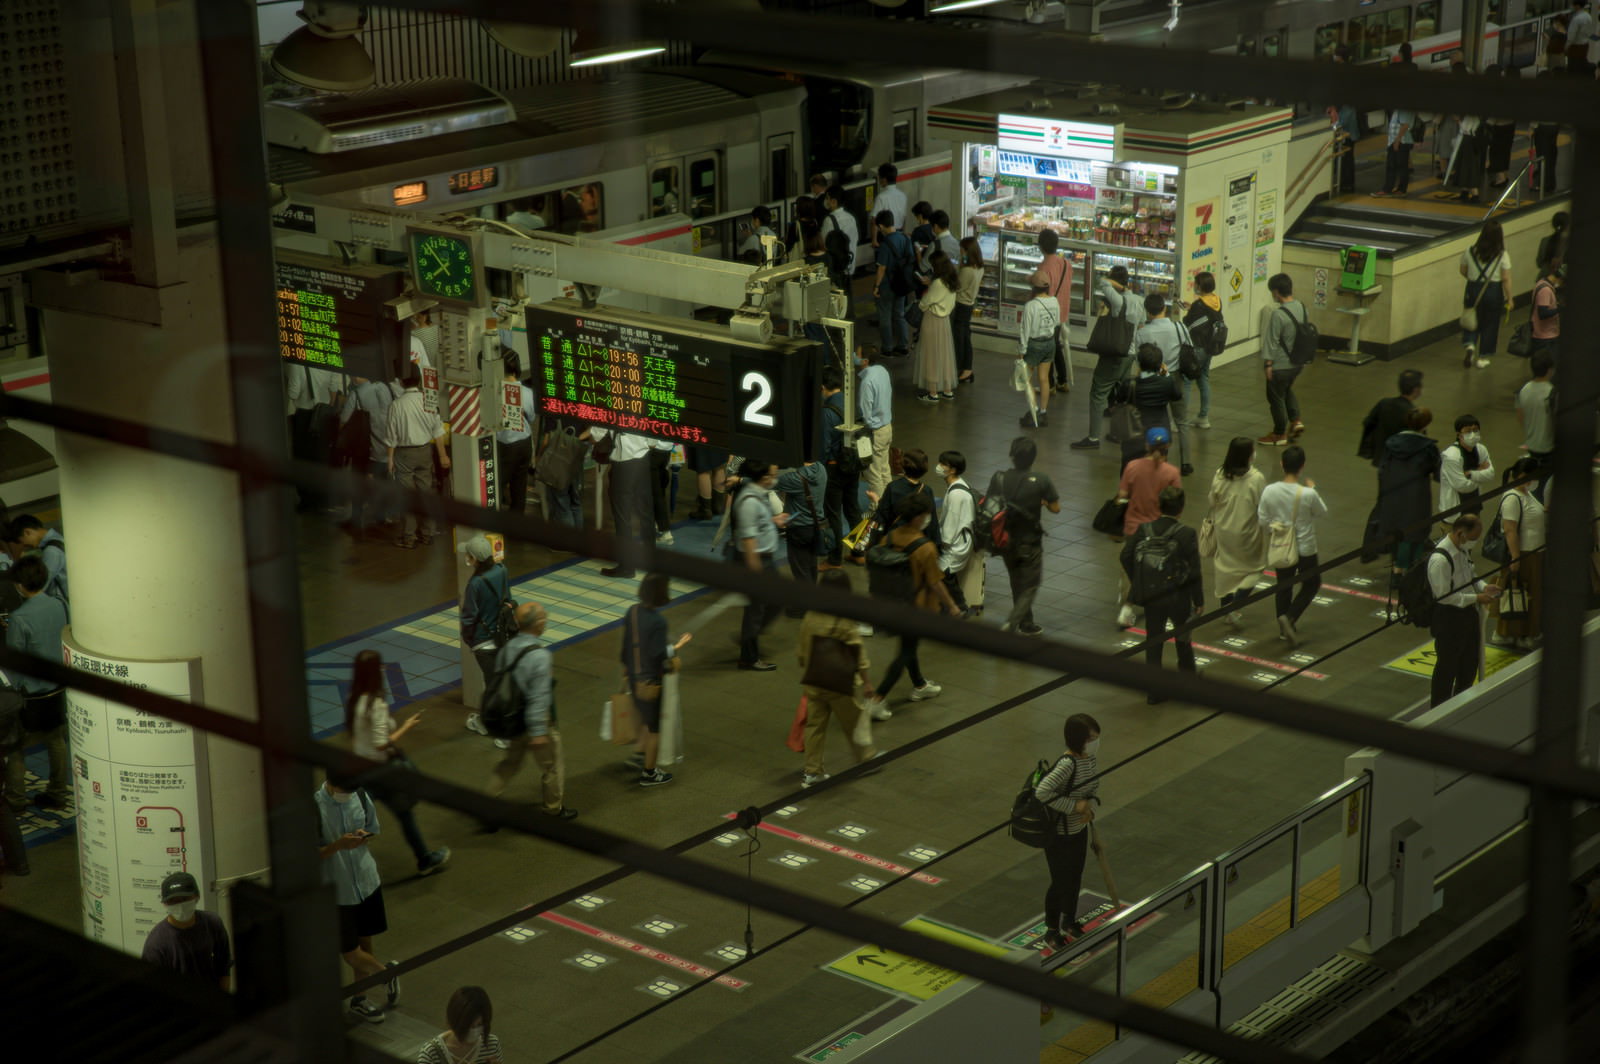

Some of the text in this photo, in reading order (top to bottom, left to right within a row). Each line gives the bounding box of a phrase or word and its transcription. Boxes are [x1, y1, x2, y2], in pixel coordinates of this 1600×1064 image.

[1196, 203, 1213, 245] 7
[438, 238, 448, 247] 12
[458, 252, 465, 260] 2
[420, 258, 427, 266] 9
[464, 265, 471, 274] 3
[462, 278, 468, 286] 4
[445, 285, 451, 294] 6
[454, 284, 461, 292] 5
[609, 349, 639, 366] 19:56
[643, 355, 676, 374] 天王寺
[424, 369, 437, 377] SOS
[610, 365, 640, 382] 20:00
[645, 372, 678, 391] 天王寺
[506, 385, 519, 393] SOS
[611, 381, 642, 398] 20:03
[743, 372, 773, 427] 2
[612, 397, 643, 414] 20:07
[647, 404, 680, 424] 天王寺
[486, 459, 495, 507] おおさか
[72, 653, 129, 678] 大阪環状線
